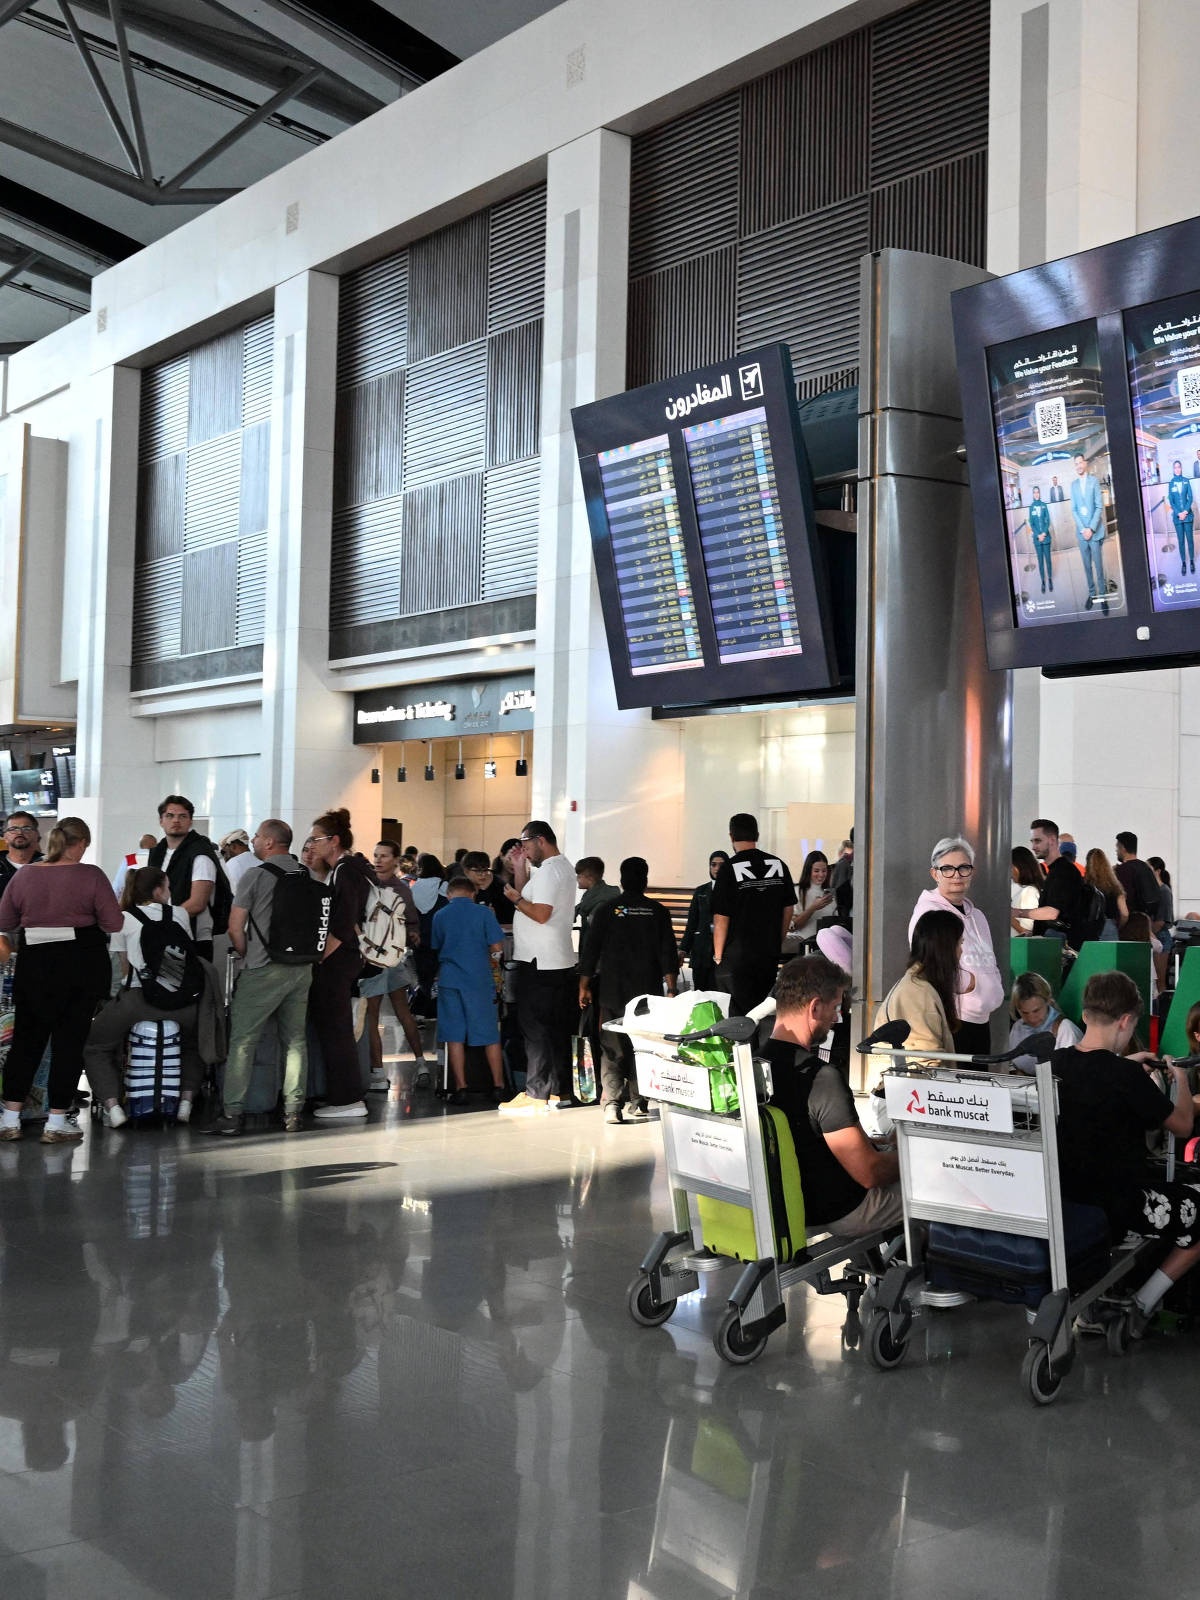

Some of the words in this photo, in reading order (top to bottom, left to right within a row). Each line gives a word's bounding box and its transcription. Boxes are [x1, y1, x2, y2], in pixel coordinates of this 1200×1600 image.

[1153, 337, 1164, 345] We
[1164, 332, 1182, 342] Value
[1182, 329, 1197, 339] your
[1024, 366, 1039, 377] Value
[1039, 364, 1052, 373] your
[1052, 357, 1079, 369] Feedback
[665, 374, 732, 420] المغادرون
[317, 897, 331, 952] adidas
[927, 1090, 965, 1104] مسقط
[966, 1094, 989, 1110] بنك
[928, 1104, 952, 1117] bank
[953, 1109, 990, 1122] muscat
[942, 1162, 954, 1170] Bank
[991, 1168, 1015, 1178] Everyday.
